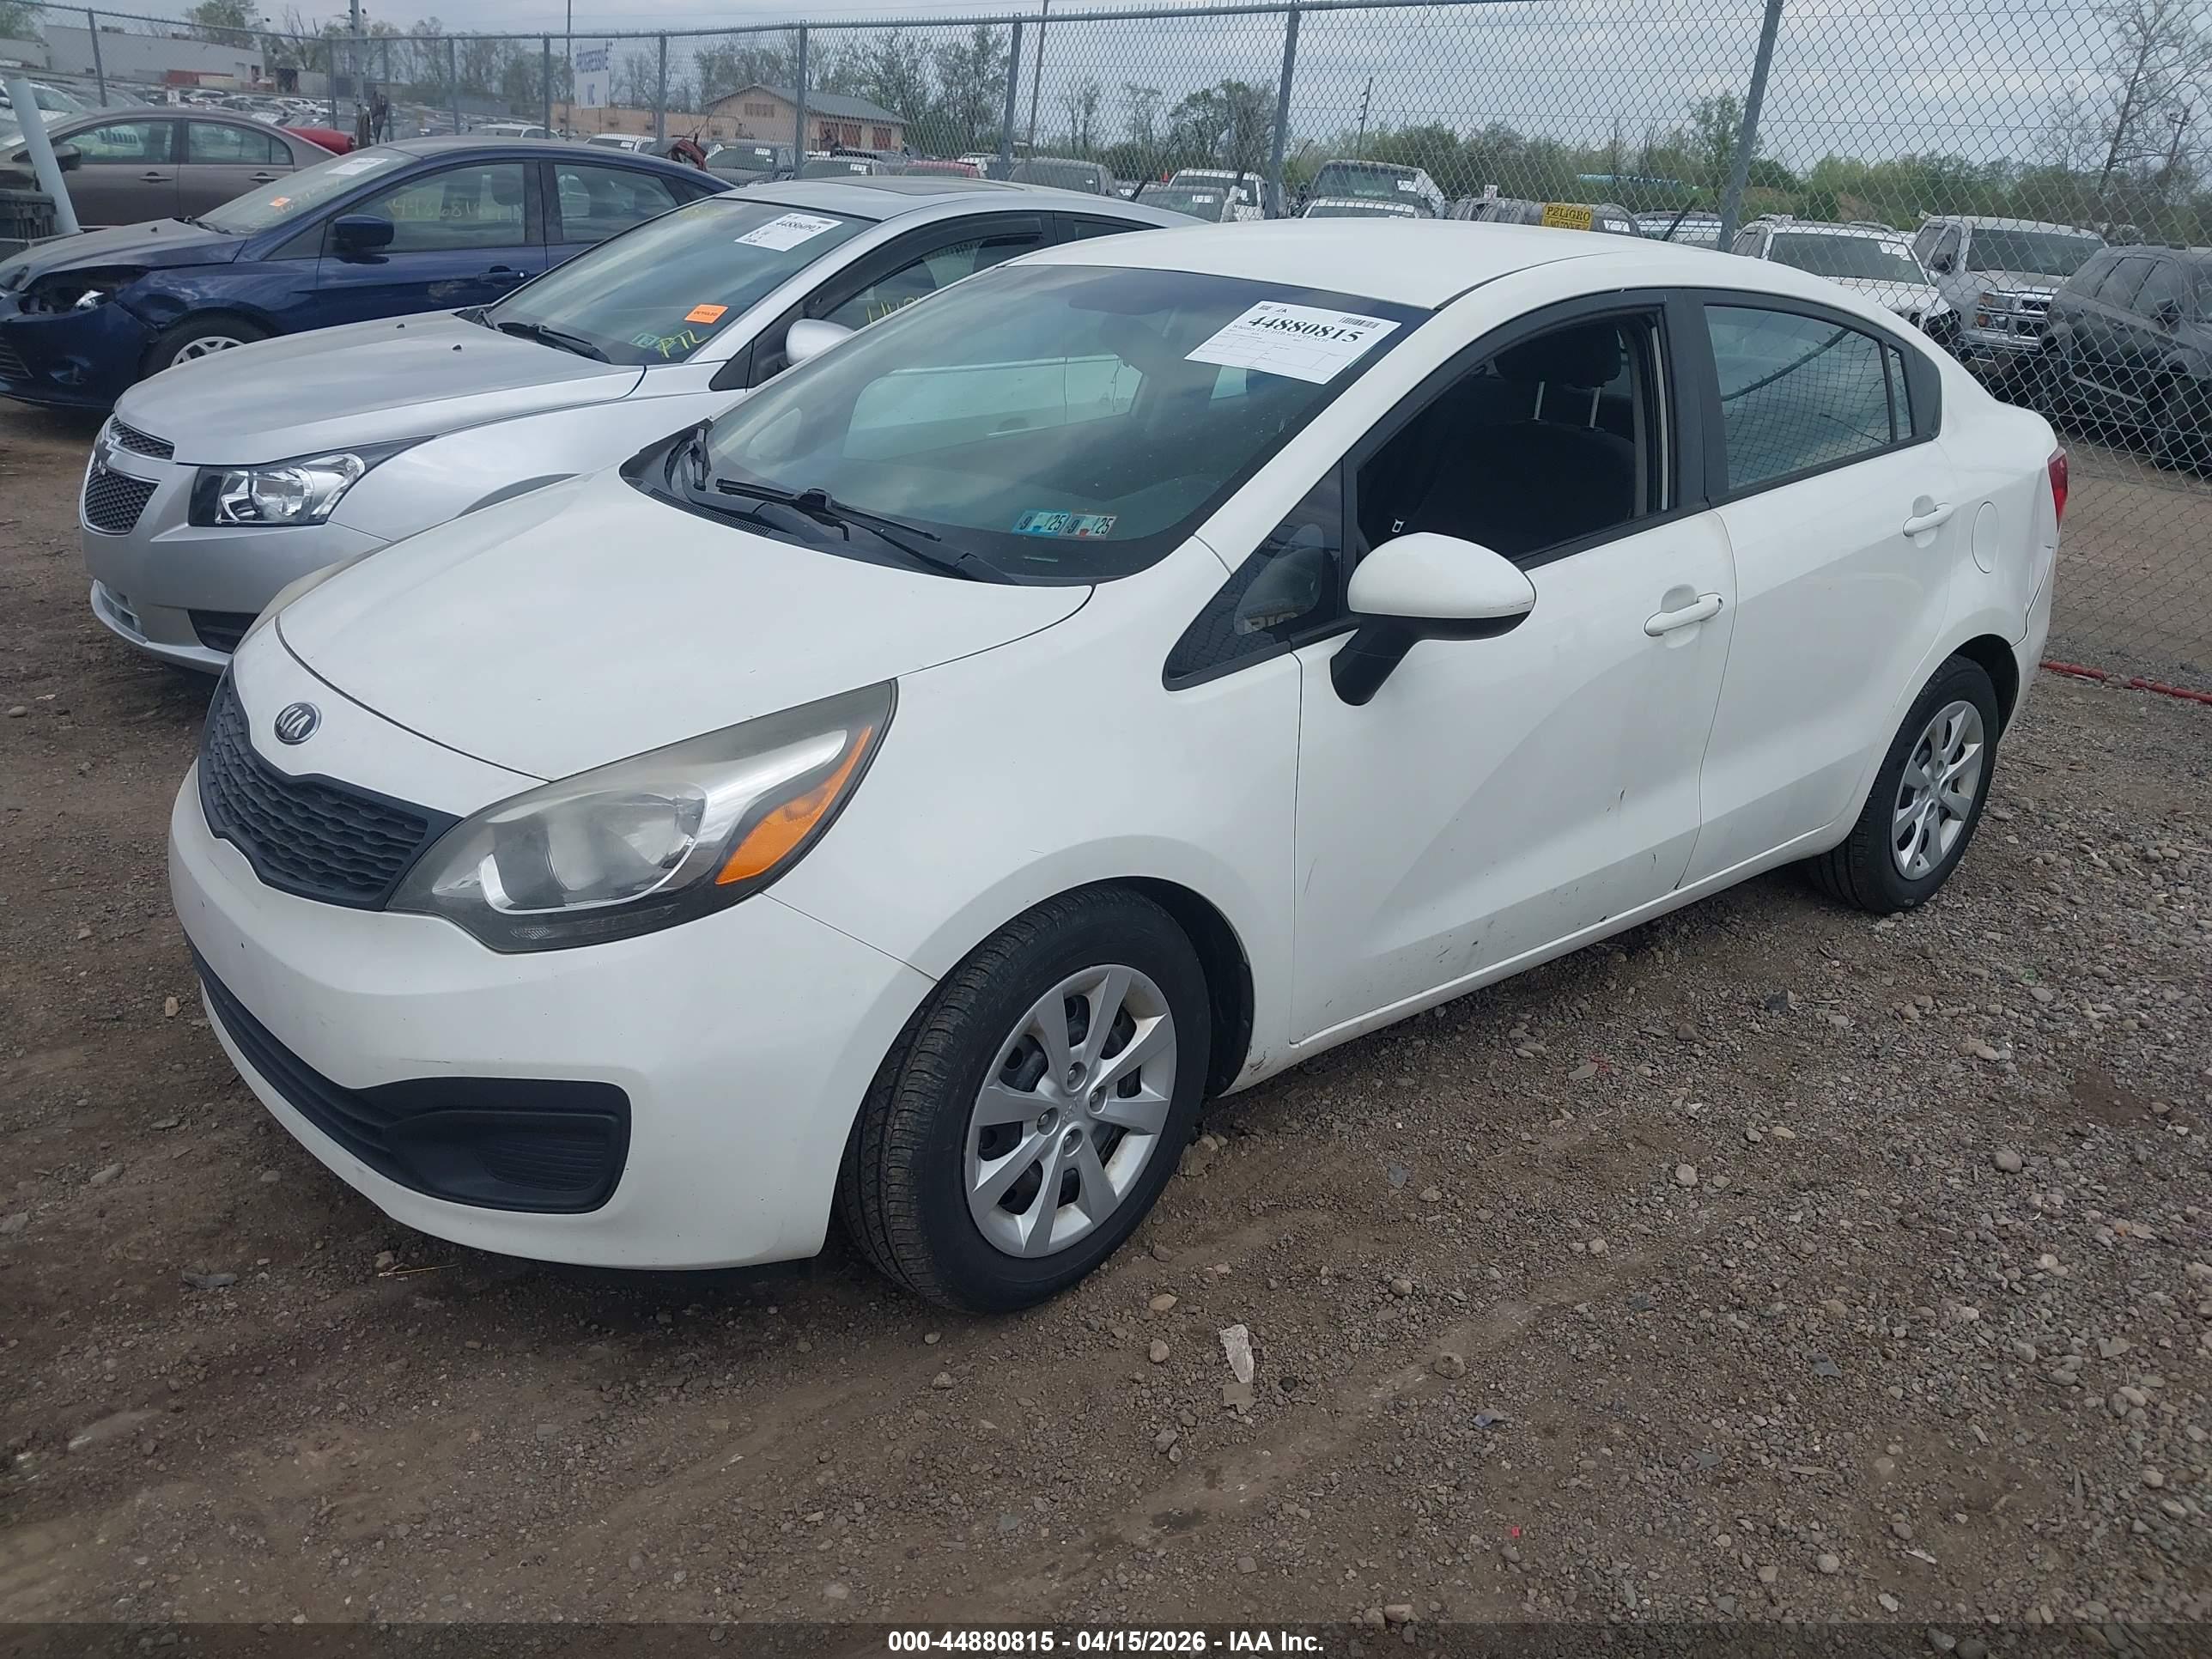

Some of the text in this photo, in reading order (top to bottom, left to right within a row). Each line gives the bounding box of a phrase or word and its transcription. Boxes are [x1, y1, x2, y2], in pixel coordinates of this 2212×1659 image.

[1546, 206, 1590, 222] PELIGRO
[1248, 314, 1364, 343] 44880815
[1047, 514, 1067, 531] 25
[1095, 517, 1115, 534] 25
